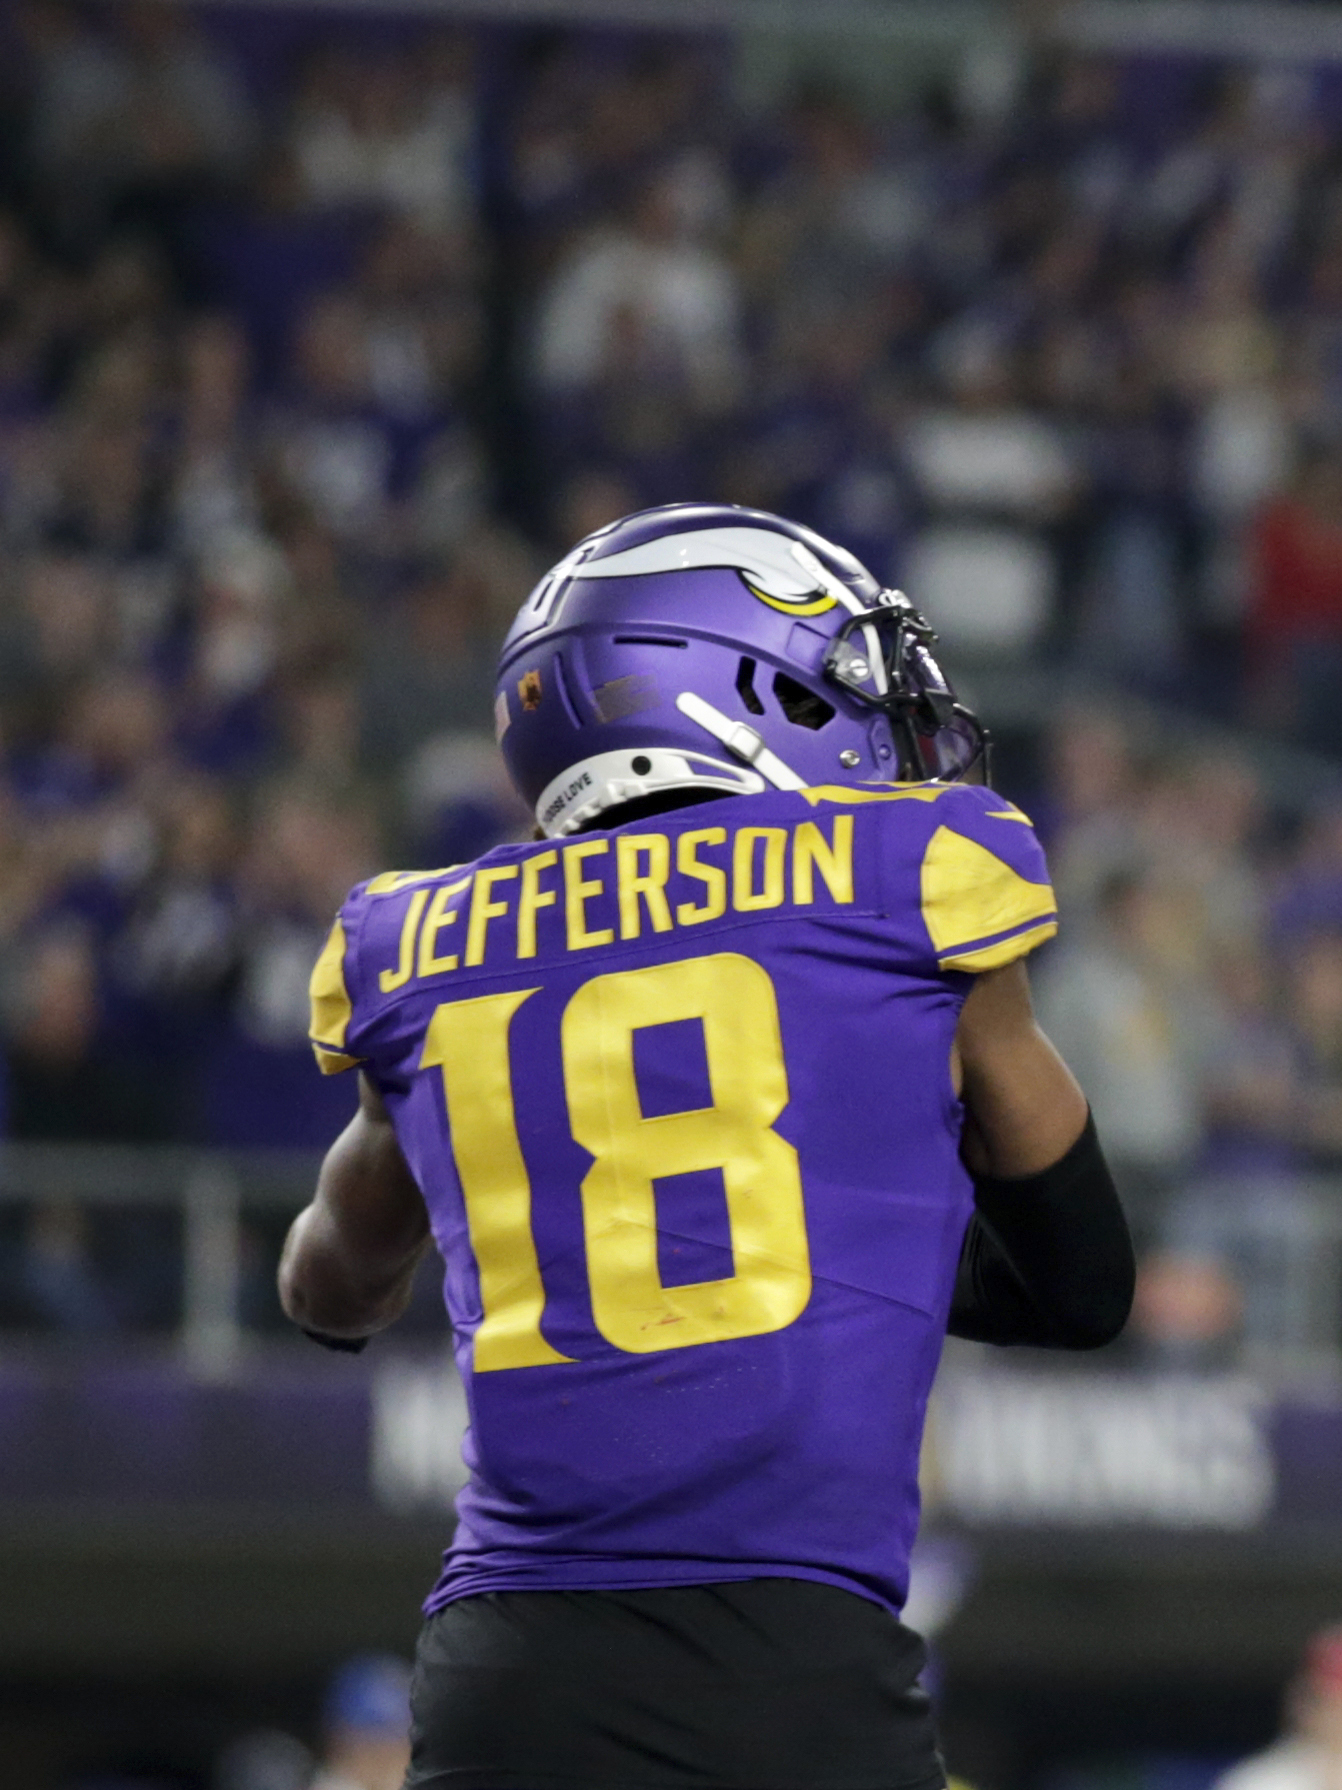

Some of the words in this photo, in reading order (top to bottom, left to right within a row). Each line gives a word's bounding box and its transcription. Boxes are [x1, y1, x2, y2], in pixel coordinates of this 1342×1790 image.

[563, 771, 593, 802] LOVE
[379, 814, 854, 994] JEFFERSON
[417, 951, 813, 1373] 18
